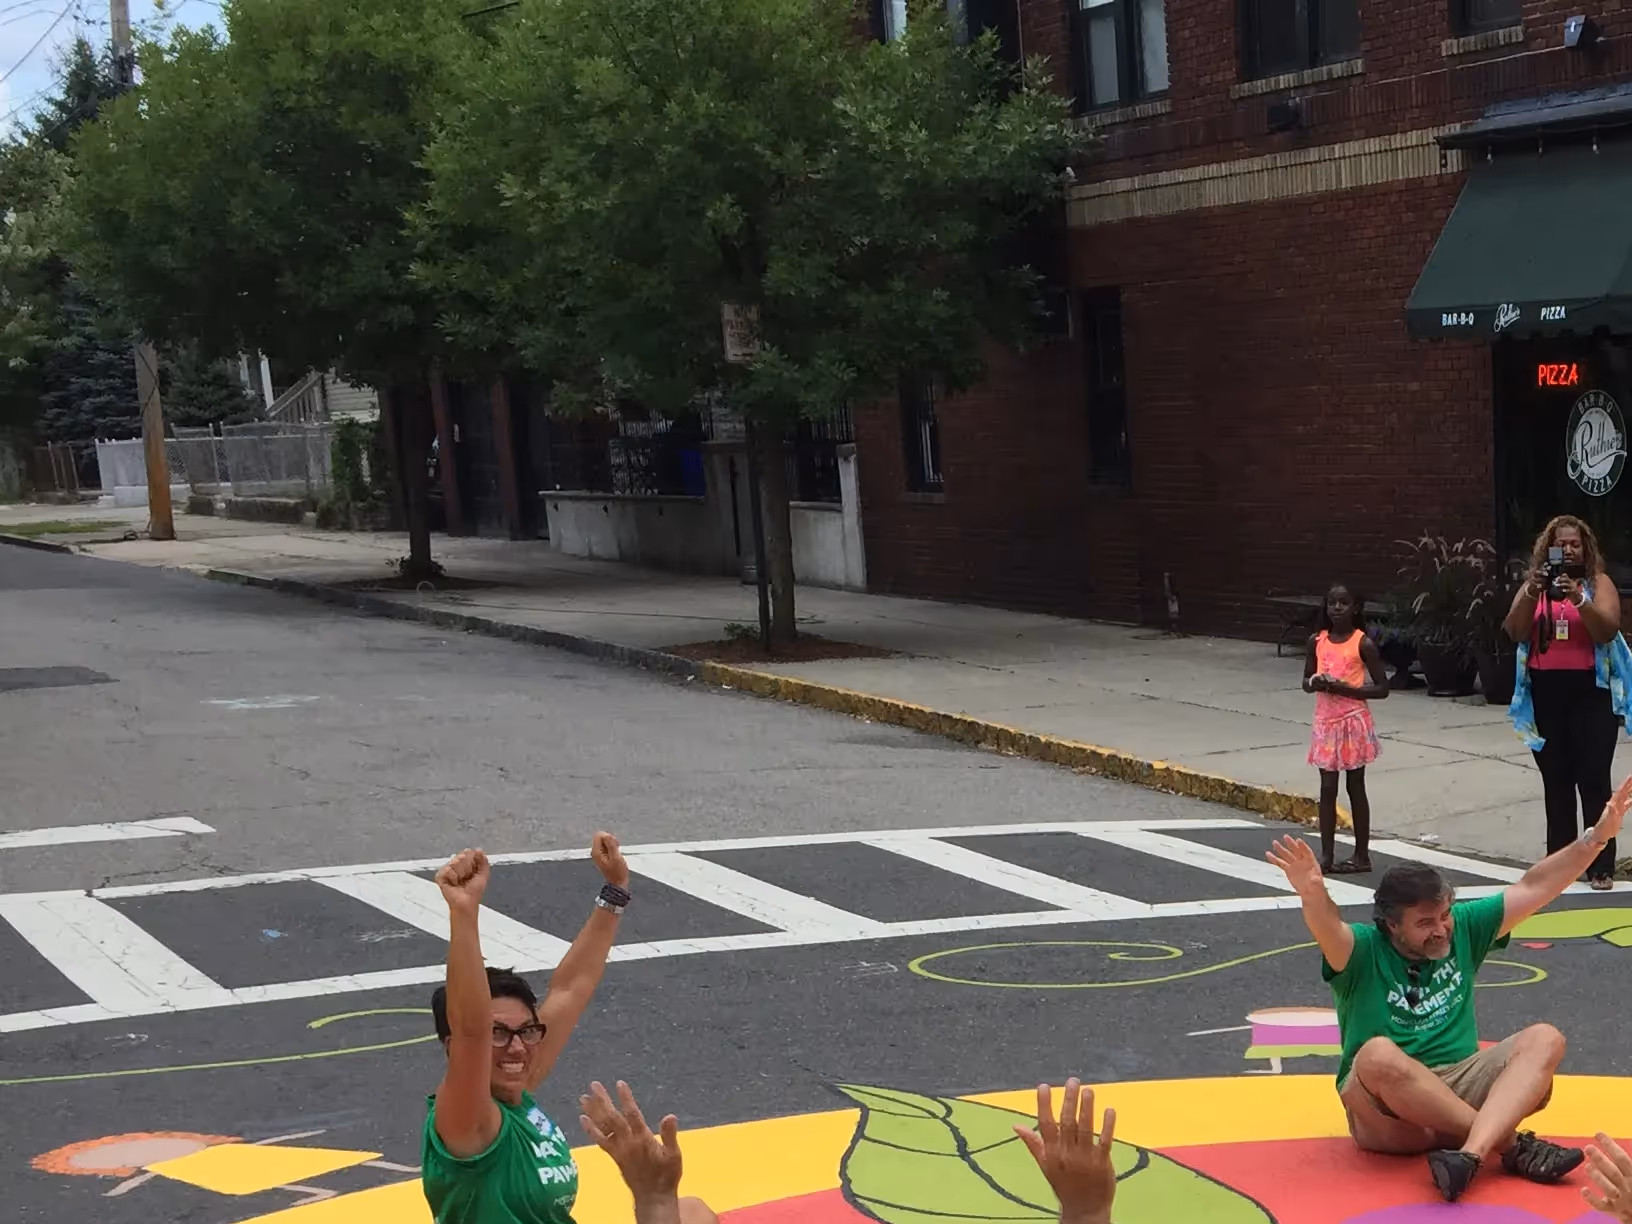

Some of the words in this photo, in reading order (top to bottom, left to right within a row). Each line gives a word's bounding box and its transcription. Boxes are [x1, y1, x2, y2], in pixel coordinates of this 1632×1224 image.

[1441, 312, 1474, 326] BAR-B-Q
[1541, 306, 1566, 320] PIZZA
[1538, 363, 1578, 386] PIZZA
[1581, 475, 1613, 493] PIZZA
